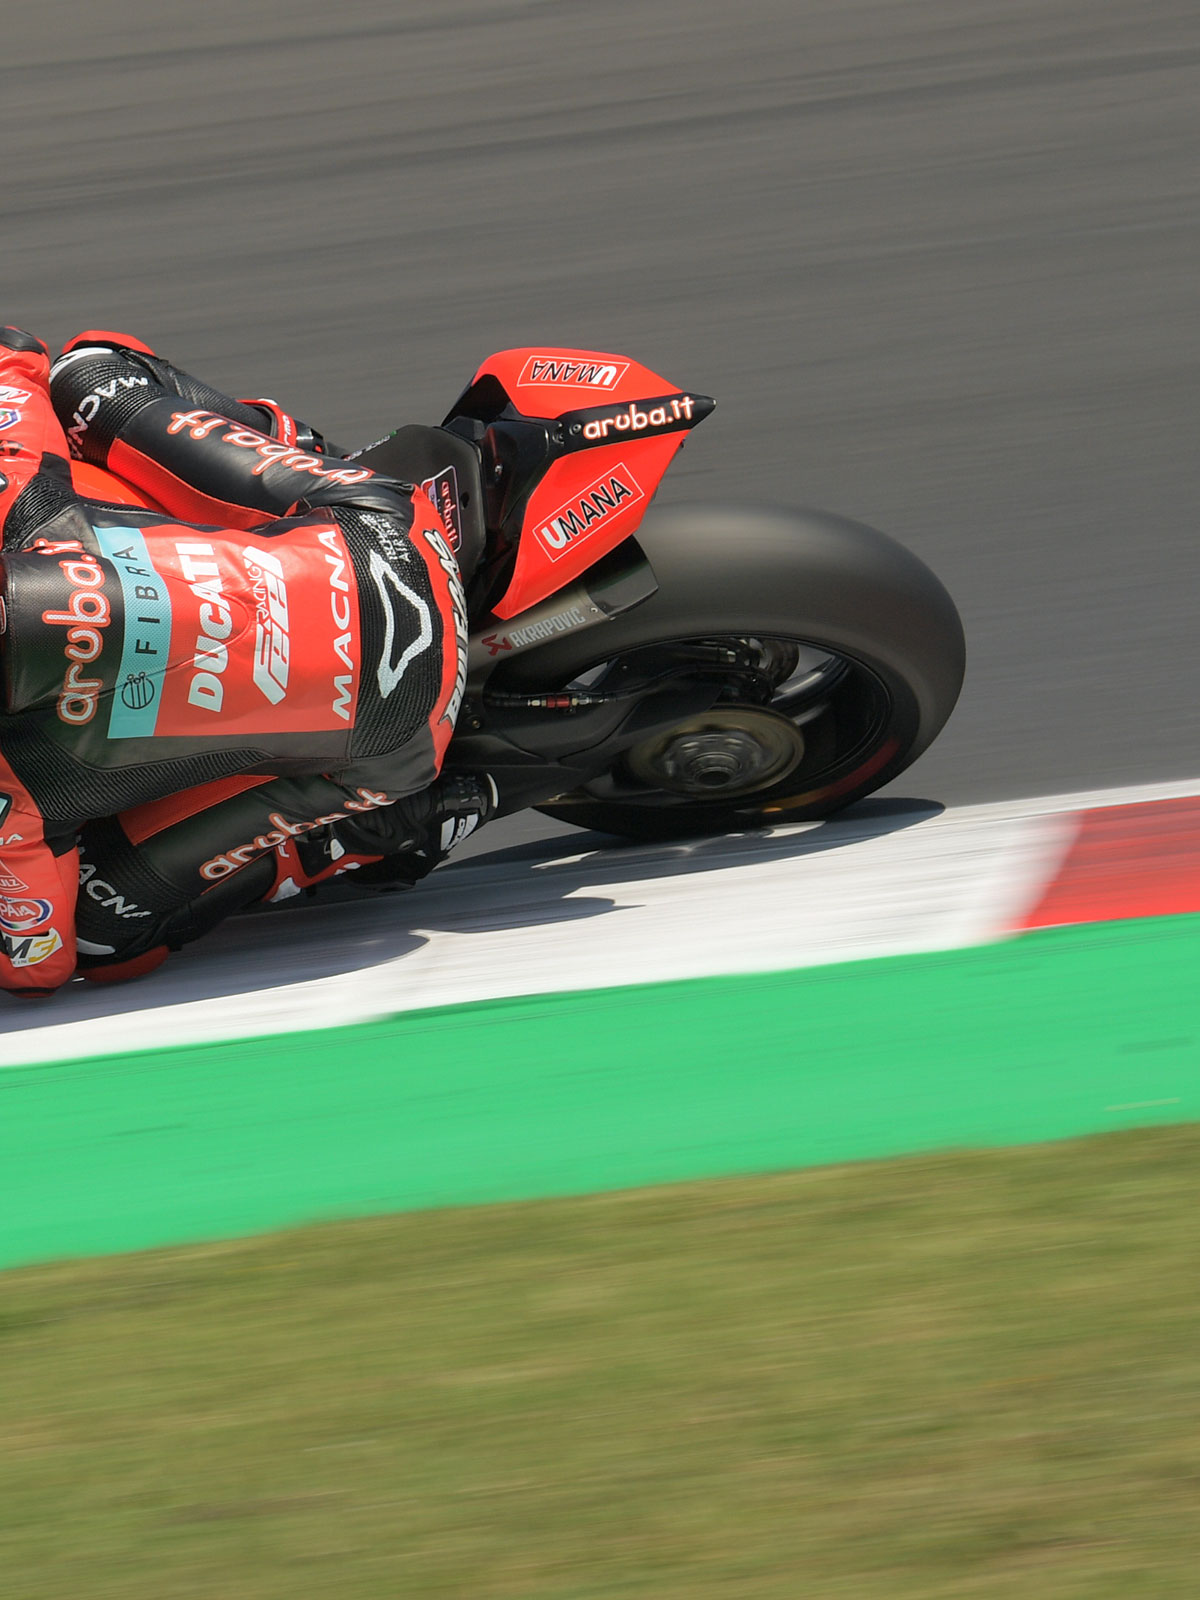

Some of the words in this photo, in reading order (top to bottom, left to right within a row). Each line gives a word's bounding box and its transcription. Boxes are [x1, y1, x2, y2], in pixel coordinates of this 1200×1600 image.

[531, 360, 617, 387] UMANA
[167, 409, 375, 484] aruba.it
[582, 396, 695, 440] aruba.it
[539, 476, 633, 550] UMANA
[30, 538, 112, 726] aruba.it
[112, 546, 159, 656] FIBRA
[177, 543, 234, 713] DUCATI
[247, 565, 270, 625] RACING
[317, 530, 351, 721] MACNA
[199, 787, 395, 881] arubait
